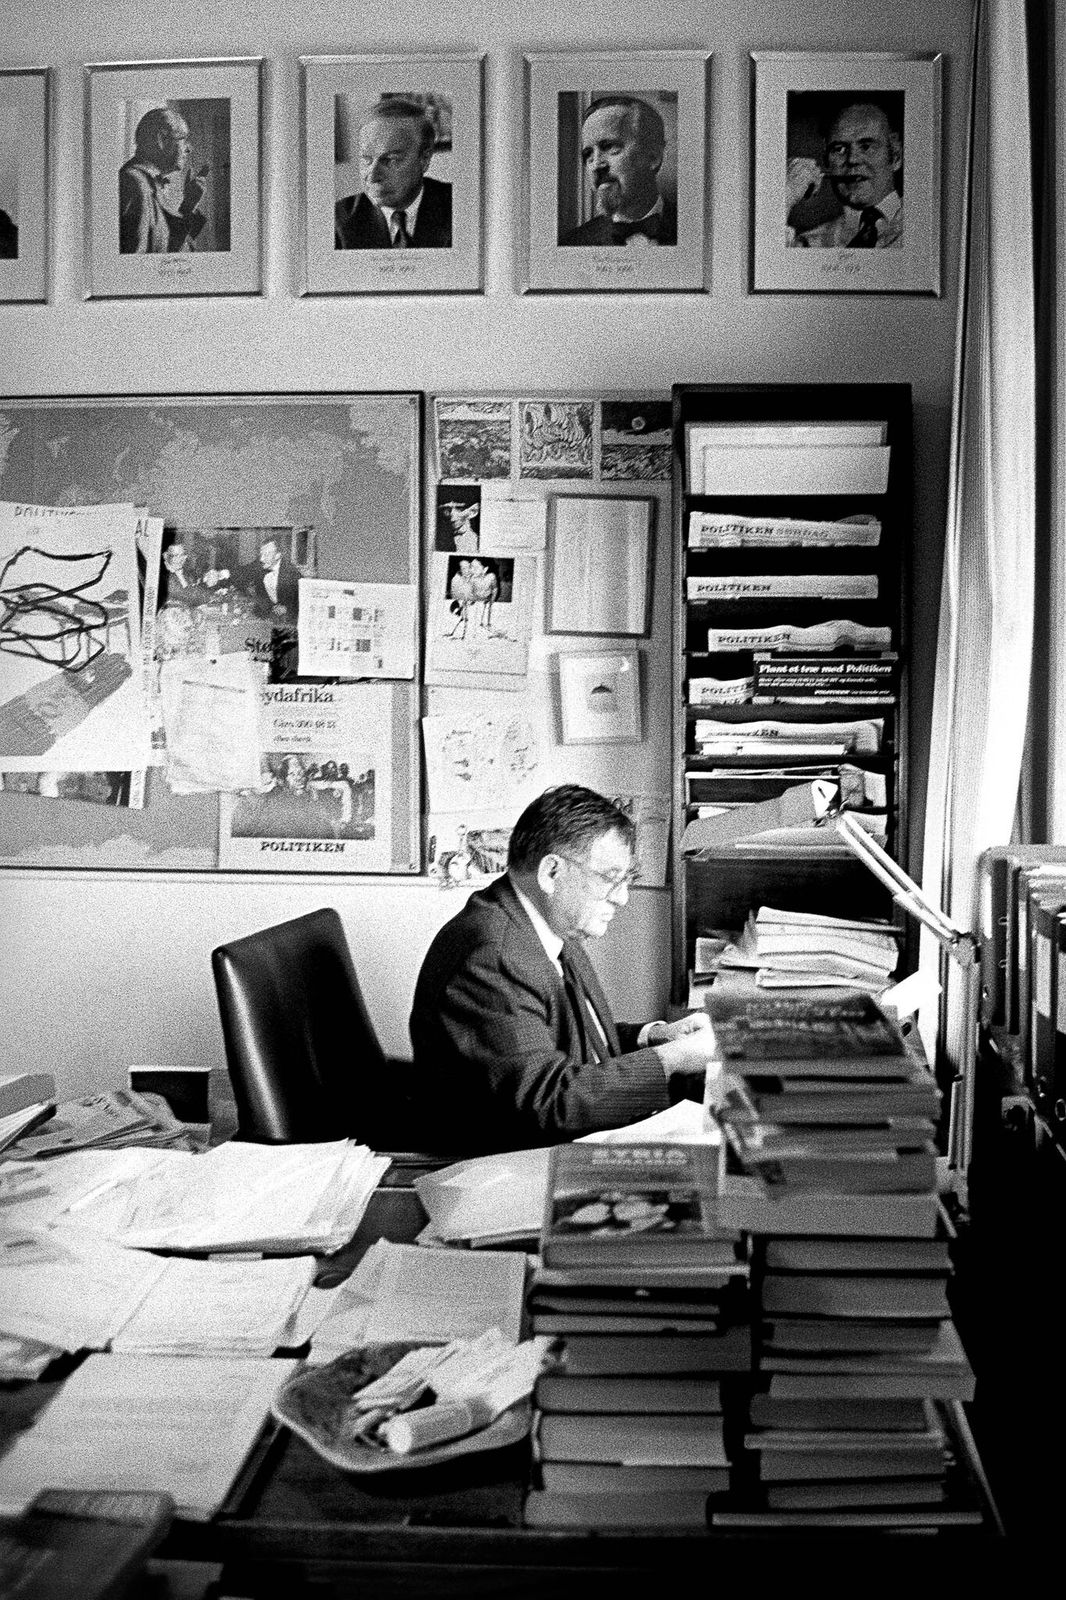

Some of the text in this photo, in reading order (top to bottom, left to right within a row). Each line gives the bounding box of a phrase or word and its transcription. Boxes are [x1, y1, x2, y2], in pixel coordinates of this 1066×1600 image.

[701, 524, 774, 535] POLITIKEN
[697, 583, 772, 592] POLITIKEN
[717, 633, 792, 644] POLITIKEN
[759, 664, 788, 674] Plant
[788, 665, 799, 674] et
[821, 664, 844, 674] med
[846, 664, 893, 674] Politiken
[262, 687, 334, 706] ydafrika
[260, 841, 346, 853] POLITIKEN
